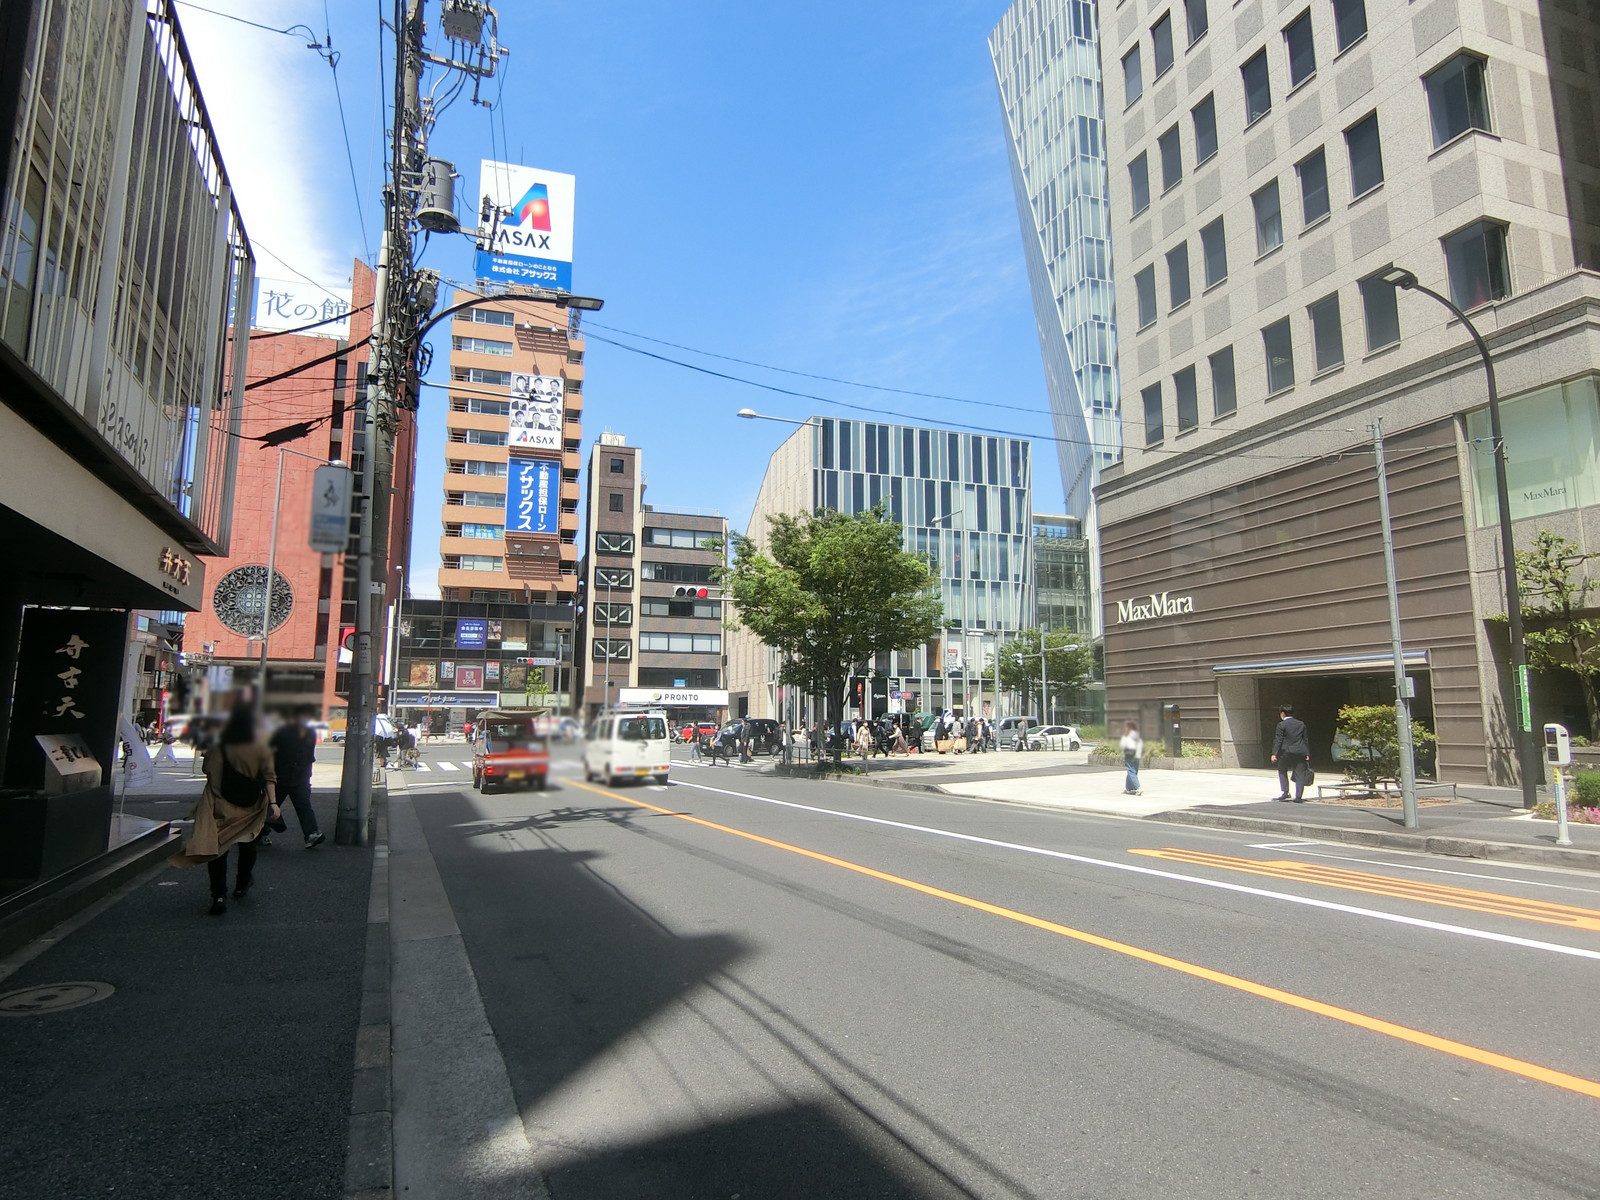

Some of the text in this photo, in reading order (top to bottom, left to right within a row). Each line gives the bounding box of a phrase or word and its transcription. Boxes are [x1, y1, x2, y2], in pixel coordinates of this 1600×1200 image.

[499, 229, 551, 250] ASAX
[492, 265, 557, 281] 株式会社 アサックス
[262, 289, 349, 325] 花の館
[529, 435, 555, 445] ASAX
[517, 460, 535, 531] アサックス
[537, 462, 550, 531] 不動産担保ローン
[1523, 486, 1567, 502] MaxMara
[1116, 591, 1194, 624] MaxMara
[664, 693, 699, 702] PRONTO
